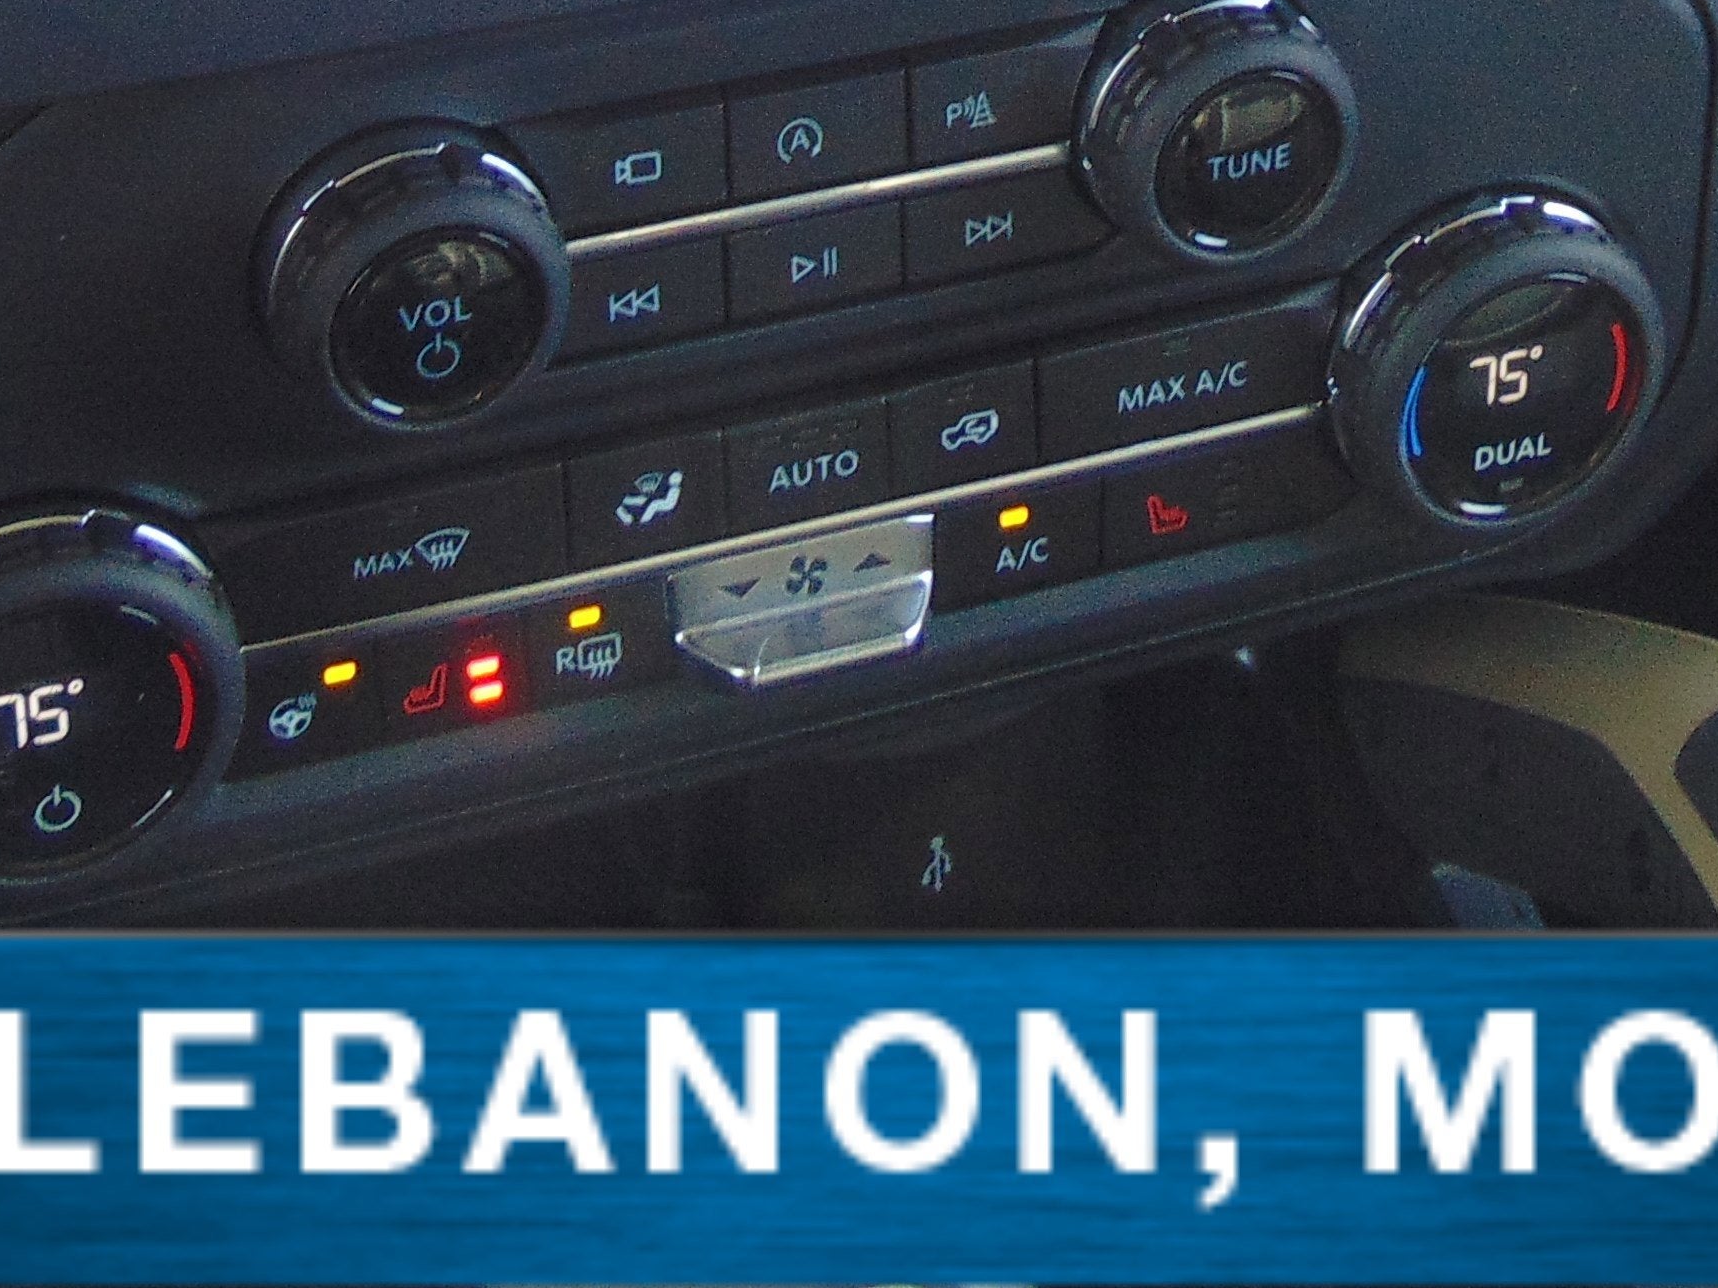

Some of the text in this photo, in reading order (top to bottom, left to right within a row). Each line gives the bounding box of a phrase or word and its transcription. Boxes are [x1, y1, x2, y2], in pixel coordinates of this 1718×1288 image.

[1207, 141, 1292, 181] TUNE
[398, 295, 473, 332] VOL
[1117, 360, 1249, 413] MAX A/C
[768, 448, 861, 494] AUTO
[1473, 431, 1553, 473] DUAL
[352, 552, 414, 581] MAX
[995, 535, 1050, 573] A/C
